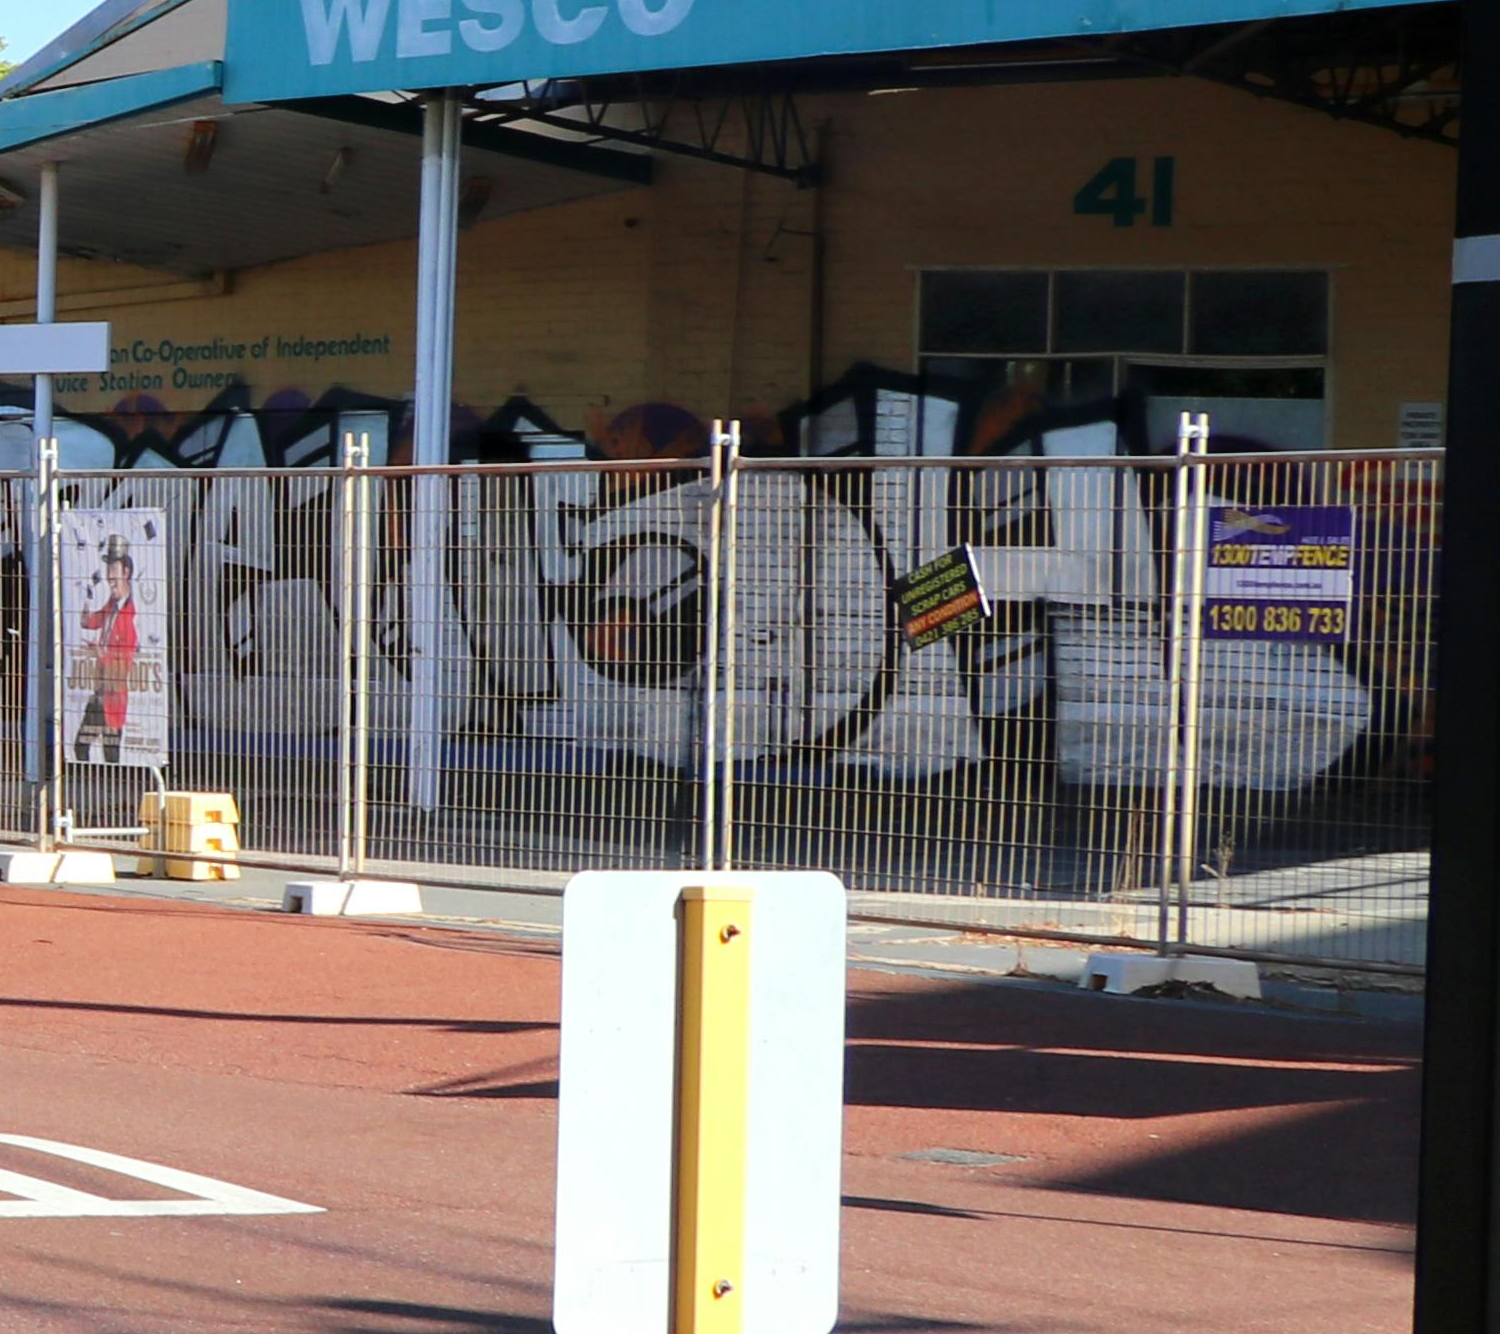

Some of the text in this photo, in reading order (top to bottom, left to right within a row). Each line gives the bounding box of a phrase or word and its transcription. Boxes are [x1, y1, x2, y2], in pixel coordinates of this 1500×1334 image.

[1074, 156, 1174, 228] 41
[132, 337, 246, 366] Co-Operative
[251, 335, 269, 357] of
[276, 334, 391, 362] Independent
[99, 371, 162, 392] Station
[908, 554, 953, 584] CASH FOR
[1211, 543, 1350, 566] 1300TEMPFENCE
[901, 563, 968, 604] UNREGISTERED
[911, 580, 967, 616] SCRAP CARS
[926, 589, 979, 624] CONDITION
[1209, 605, 1344, 633] 1300 836 733
